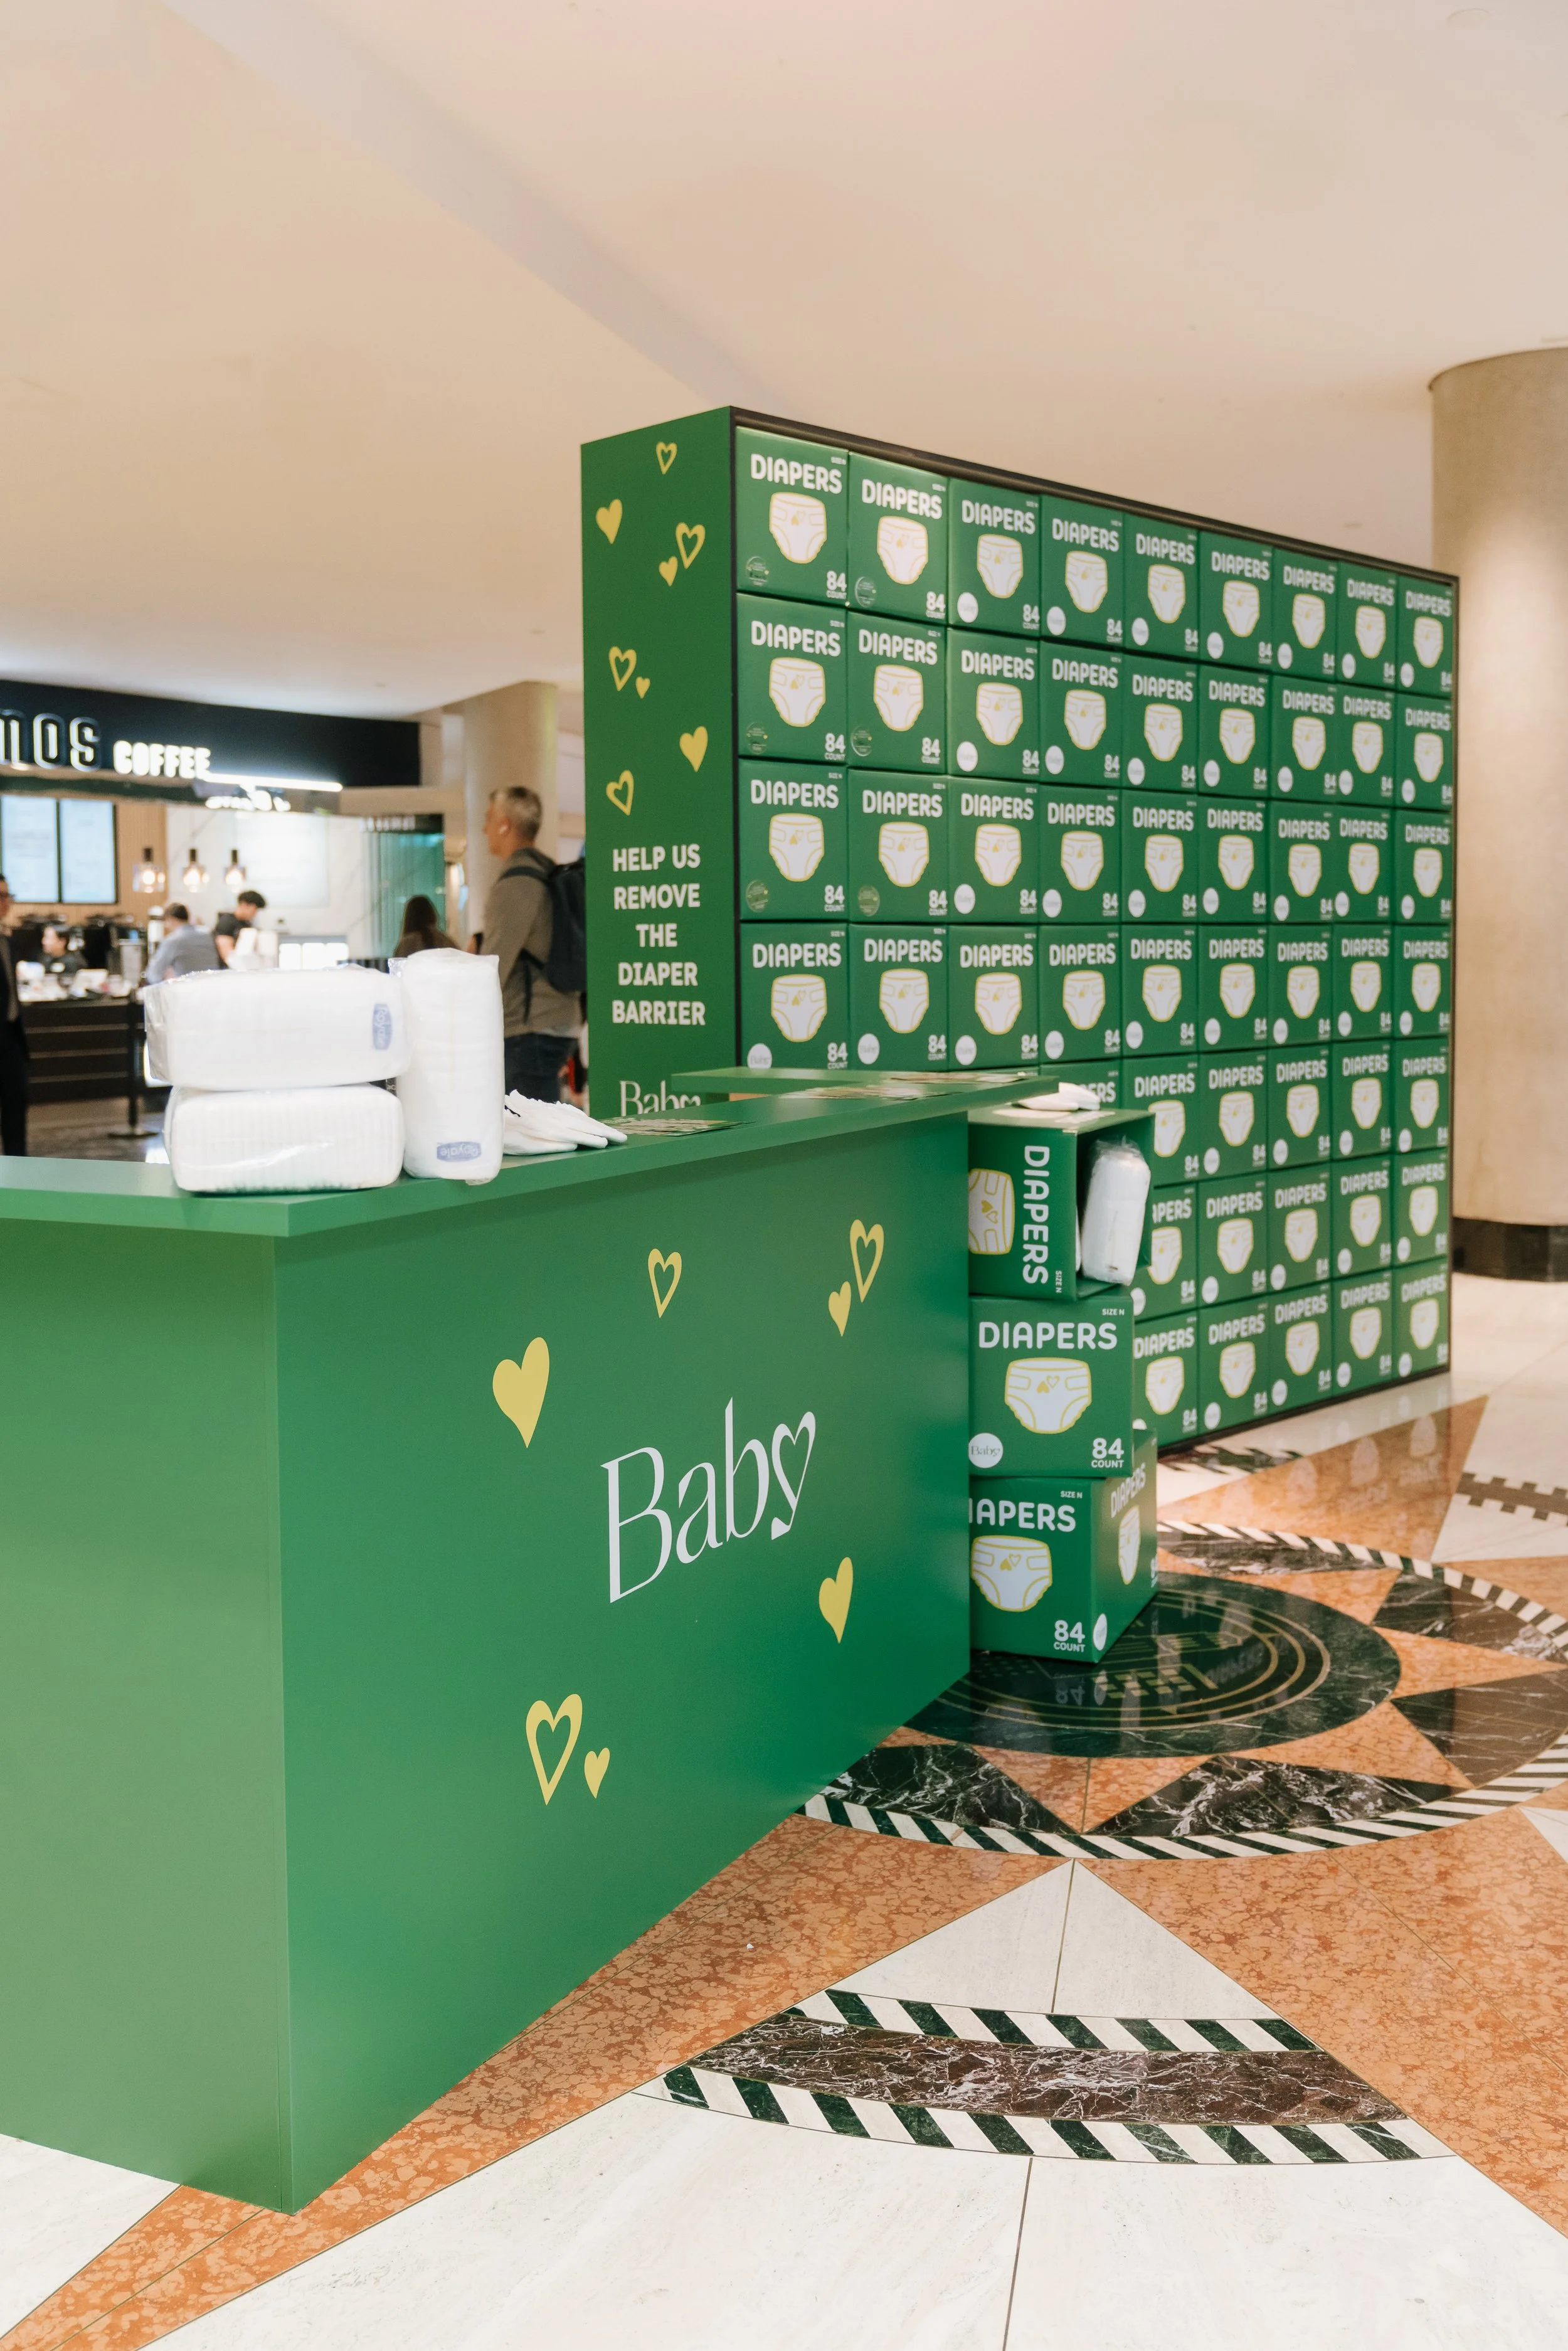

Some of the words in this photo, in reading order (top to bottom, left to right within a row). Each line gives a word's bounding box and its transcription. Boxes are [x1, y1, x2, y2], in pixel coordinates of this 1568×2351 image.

[750, 453, 842, 494] DIAPERS
[861, 478, 943, 520] DIAPERS
[961, 499, 1036, 535] DIAPERS
[1052, 517, 1120, 552] DIAPERS
[1136, 533, 1195, 565] DIAPERS
[1211, 551, 1270, 581] DIAPERS
[827, 571, 847, 592] 84
[1283, 565, 1335, 594] DIAPERS
[926, 592, 946, 612] 84
[1347, 579, 1394, 606] DIAPERS
[1406, 591, 1450, 617] DIAPERS
[1023, 603, 1040, 623] 84
[751, 620, 841, 657] DIAPERS
[1107, 618, 1123, 636] 84
[1185, 628, 1199, 645] 84
[859, 629, 938, 666] DIAPERS
[1259, 641, 1273, 657] 84
[961, 649, 1035, 681] DIAPERS
[1052, 658, 1118, 689] DIAPERS
[1132, 674, 1193, 702] DIAPERS
[1209, 680, 1265, 707] DIAPERS
[1283, 689, 1334, 715] DIAPERS
[1343, 696, 1391, 720] DIAPERS
[1406, 708, 1450, 731] DIAPERS
[825, 733, 846, 753] 84
[921, 737, 940, 757] 84
[113, 740, 211, 780] COFFEE
[1022, 750, 1039, 768] 84
[1104, 754, 1120, 772] 84
[1181, 765, 1196, 780] 84
[1254, 767, 1267, 782] 84
[750, 779, 839, 809] DIAPERS
[862, 789, 943, 818] DIAPERS
[961, 793, 1034, 820] DIAPERS
[1047, 802, 1115, 827] DIAPERS
[1133, 807, 1194, 831] DIAPERS
[1207, 809, 1263, 832] DIAPERS
[1278, 819, 1330, 841] DIAPERS
[1340, 818, 1387, 840] DIAPERS
[1406, 825, 1449, 845] DIAPERS
[613, 846, 665, 871] HELP
[672, 844, 700, 868] US
[615, 884, 700, 910] REMOVE
[825, 884, 845, 904] 84
[929, 889, 948, 908] 84
[1020, 888, 1037, 907] 84
[1103, 892, 1118, 909] 84
[1182, 893, 1197, 910] 84
[1253, 891, 1266, 906] 84
[636, 923, 677, 947] THE
[753, 942, 842, 969] DIAPERS
[864, 938, 943, 963] DIAPERS
[960, 943, 1034, 968] DIAPERS
[1049, 943, 1116, 967] DIAPERS
[1130, 938, 1192, 960] DIAPERS
[1209, 938, 1264, 959] DIAPERS
[1278, 942, 1328, 962] DIAPERS
[1342, 938, 1389, 957] DIAPERS
[1404, 941, 1449, 959] DIAPERS
[619, 962, 697, 985] DIAPER
[613, 1000, 705, 1025] BARRIER
[374, 1007, 389, 1046] Royale
[1180, 1022, 1195, 1039] 84
[1254, 1017, 1268, 1032] 84
[928, 1034, 946, 1053] 84
[1021, 1034, 1038, 1052] 84
[1104, 1029, 1120, 1046] 84
[827, 1043, 848, 1061] 84
[1276, 1059, 1327, 1083] DIAPERS
[1343, 1054, 1388, 1076] DIAPERS
[1402, 1056, 1447, 1077] DIAPERS
[1135, 1073, 1195, 1098] DIAPERS
[1209, 1065, 1264, 1090] DIAPERS
[1185, 1154, 1199, 1171] 84
[1253, 1143, 1266, 1159] 84
[1340, 1170, 1388, 1196] DIAPERS
[1206, 1191, 1263, 1219] DIAPERS
[1275, 1182, 1327, 1209] DIAPERS
[1023, 1146, 1049, 1283] DIAPERS
[1152, 1198, 1192, 1224] PERS
[1181, 1280, 1195, 1293] 84
[1253, 1270, 1266, 1285] 84
[1341, 1282, 1390, 1309] DIAPERS
[1275, 1294, 1328, 1324] DIAPERS
[980, 1322, 1117, 1349] DIAPERS
[1209, 1313, 1265, 1345] DIAPERS
[1134, 1327, 1195, 1359] DIAPERS
[1254, 1391, 1268, 1407] 84
[1182, 1408, 1197, 1425] 84
[970, 1445, 1001, 1457] Baby
[1093, 1438, 1124, 1459] 84
[600, 1397, 816, 1603] Baby
[1061, 1490, 1076, 1499] SIZE
[1111, 1463, 1146, 1519] DIAPERS
[969, 1498, 1076, 1532] IAPERS
[1054, 1620, 1086, 1643] 84
[1053, 1642, 1086, 1652] COUNT
